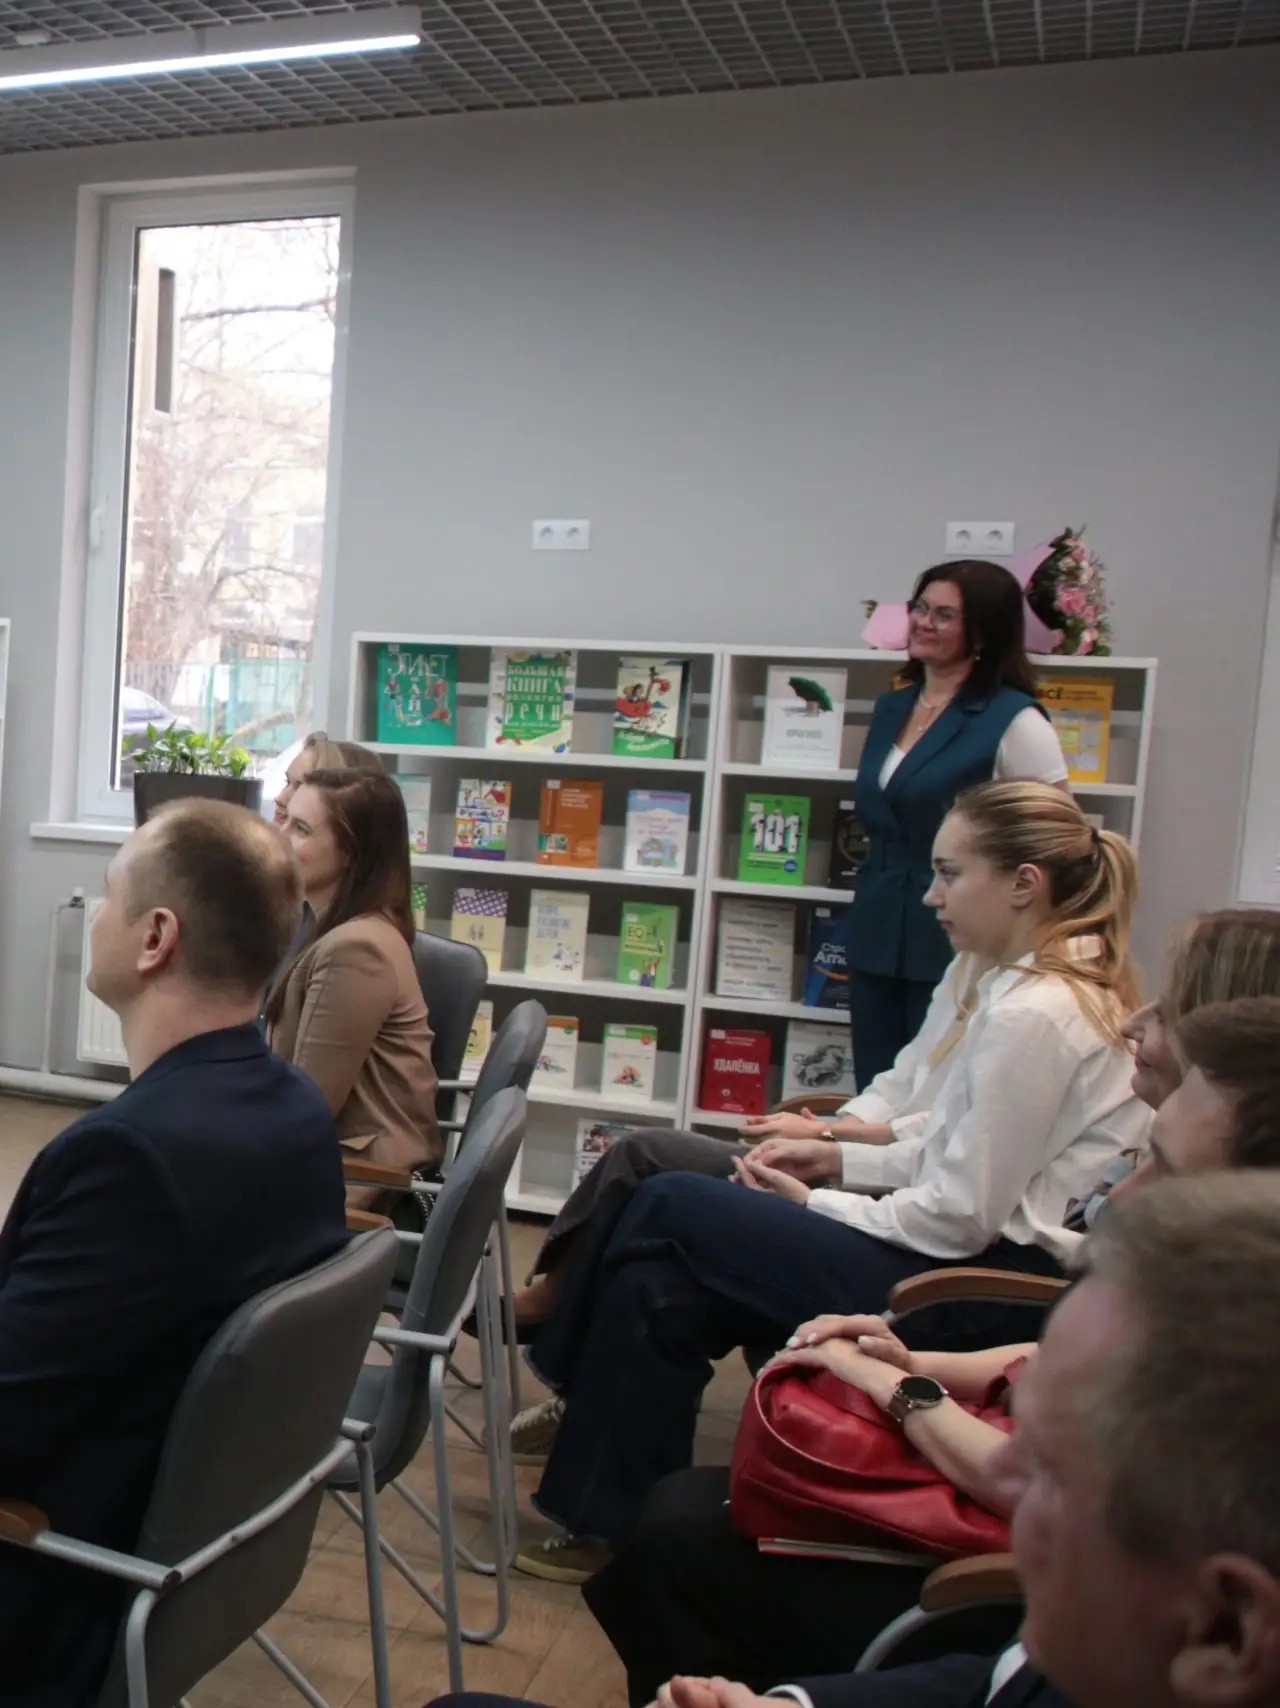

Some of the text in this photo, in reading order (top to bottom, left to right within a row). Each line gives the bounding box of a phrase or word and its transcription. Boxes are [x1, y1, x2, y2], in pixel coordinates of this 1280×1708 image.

[507, 665, 564, 677] БОЛЬШАЯ
[507, 677, 562, 693] КНИГА
[751, 812, 801, 854] 101
